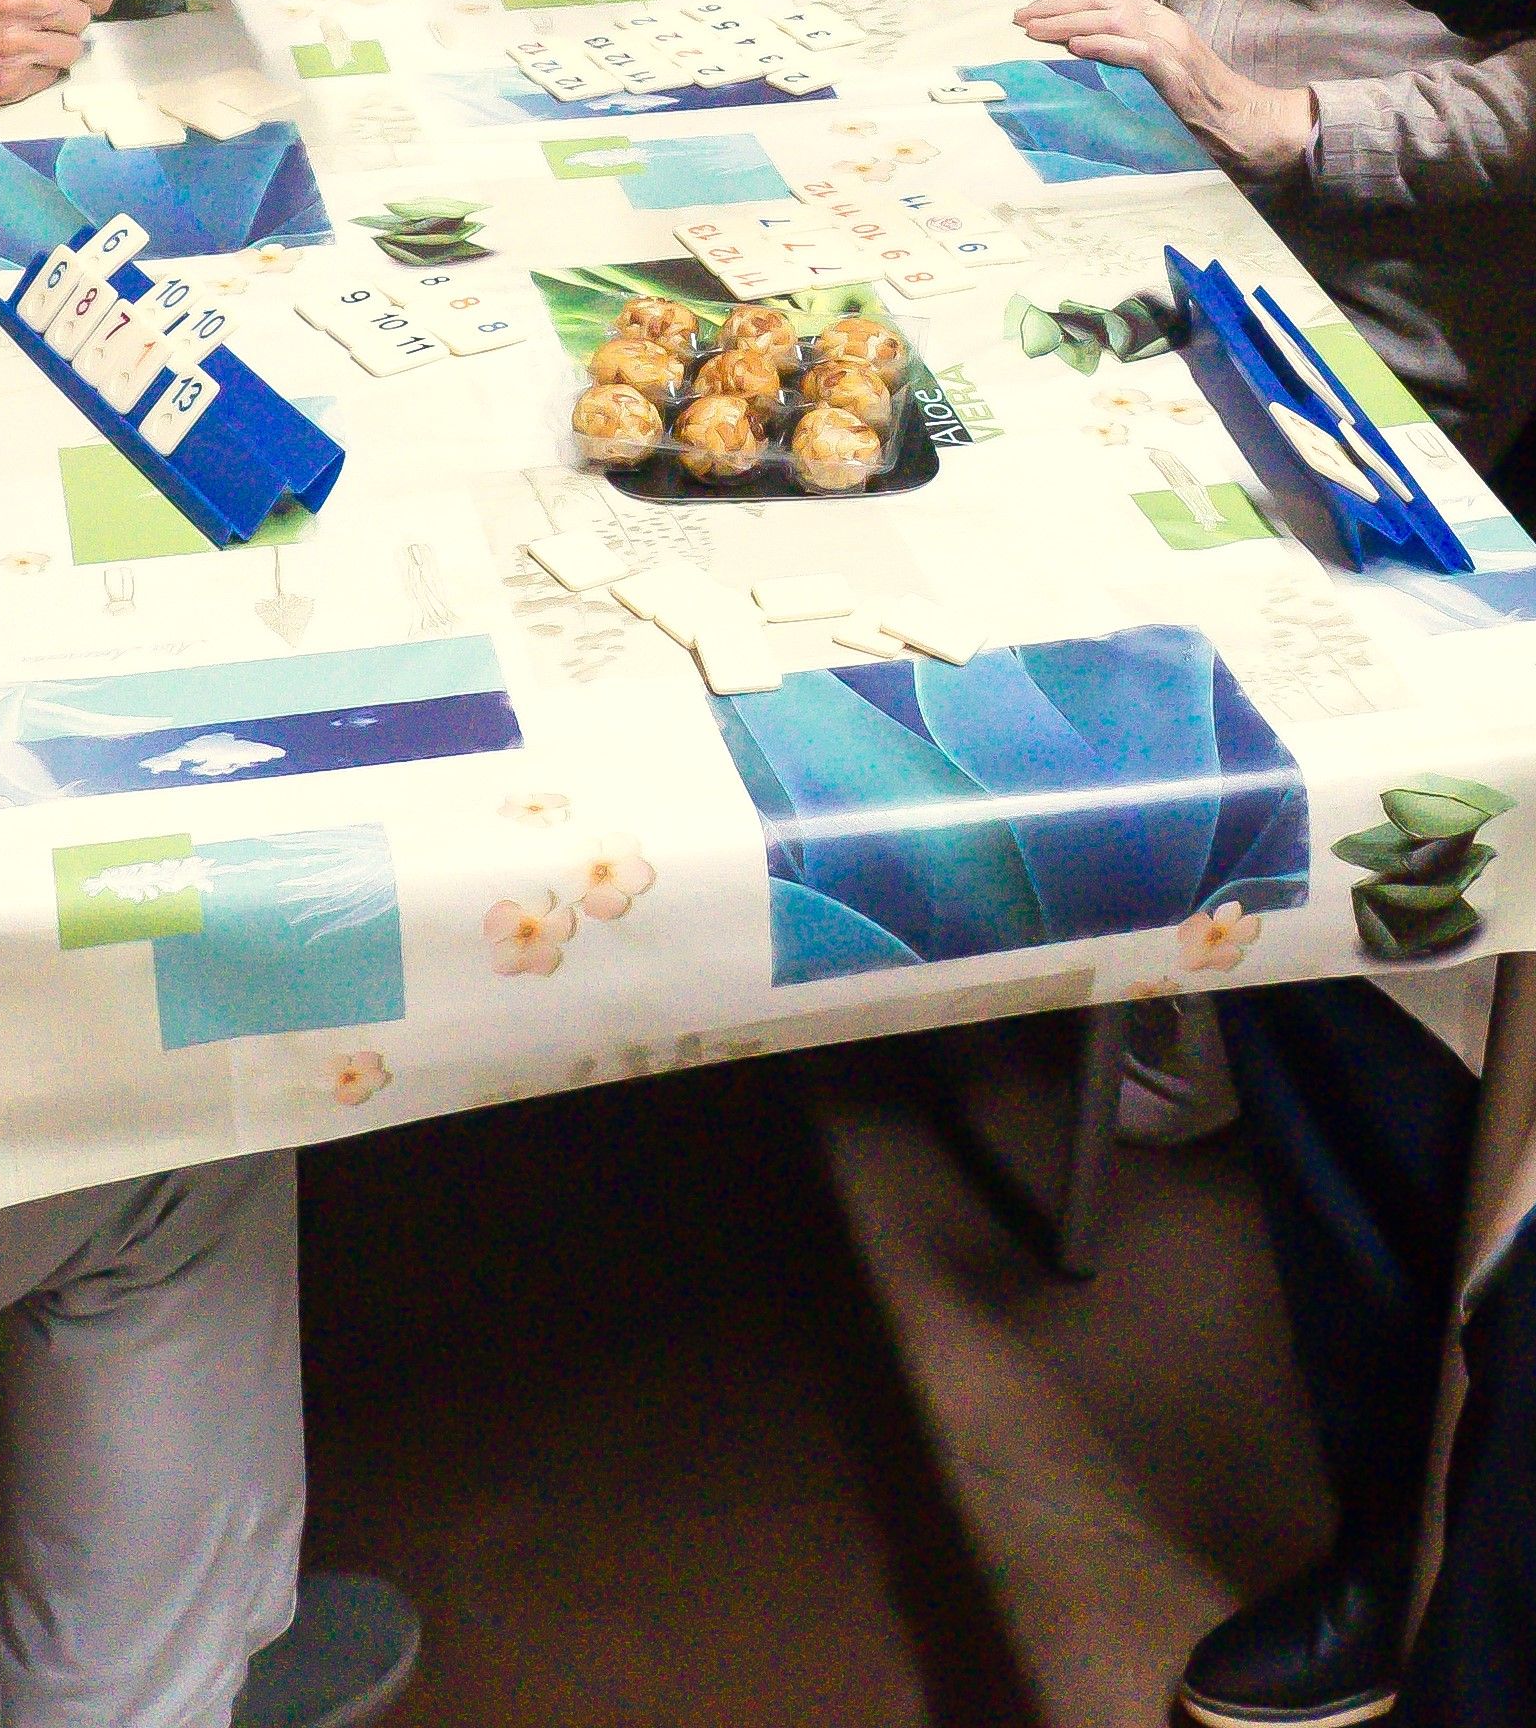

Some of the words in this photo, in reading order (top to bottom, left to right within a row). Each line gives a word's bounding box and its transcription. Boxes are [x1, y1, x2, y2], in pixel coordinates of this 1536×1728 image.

[711, 21, 740, 30] 5
[806, 30, 831, 38] 3
[531, 59, 563, 73] 12
[604, 53, 636, 66] 12
[759, 54, 783, 63] 3
[625, 71, 657, 83] 11
[697, 66, 725, 75] 2
[784, 72, 809, 82] 2
[555, 77, 587, 90] 12
[803, 180, 838, 198] 12
[899, 194, 934, 210] 11
[831, 203, 862, 217] 11
[688, 224, 723, 240] 13
[851, 224, 886, 241] 10
[103, 229, 128, 252] 6
[708, 246, 744, 264] 12
[47, 261, 68, 289] 6
[420, 276, 450, 286] 8
[733, 272, 769, 287] 11
[904, 272, 934, 283] 8
[156, 279, 190, 308] 10
[76, 288, 98, 316] 8
[449, 297, 481, 310] 8
[105, 311, 131, 341] 7
[191, 308, 225, 339] 10
[370, 313, 409, 330] 10
[477, 322, 509, 333] 8
[396, 336, 435, 355] 11
[172, 376, 202, 412] 13
[915, 388, 974, 446] Aloe
